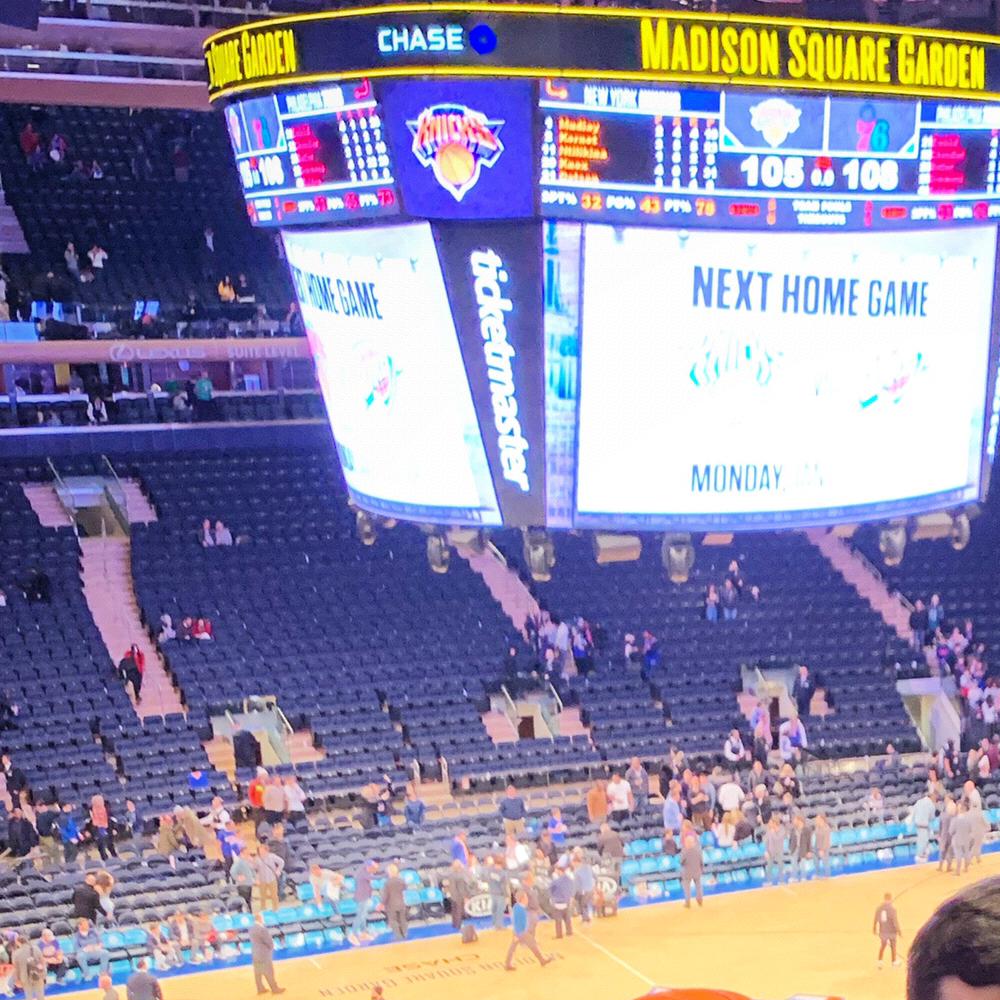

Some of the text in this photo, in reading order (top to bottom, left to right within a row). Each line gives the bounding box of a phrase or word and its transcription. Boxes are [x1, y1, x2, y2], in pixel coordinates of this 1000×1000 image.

[241, 29, 297, 79] GARDEN
[377, 25, 464, 54] CHASE
[640, 17, 986, 90] MADISON SQUARE GARDEN
[740, 154, 805, 188] 105
[336, 278, 383, 320] GAME
[692, 265, 929, 317] NEXT HOME GAME
[470, 248, 530, 492] ticketmaster
